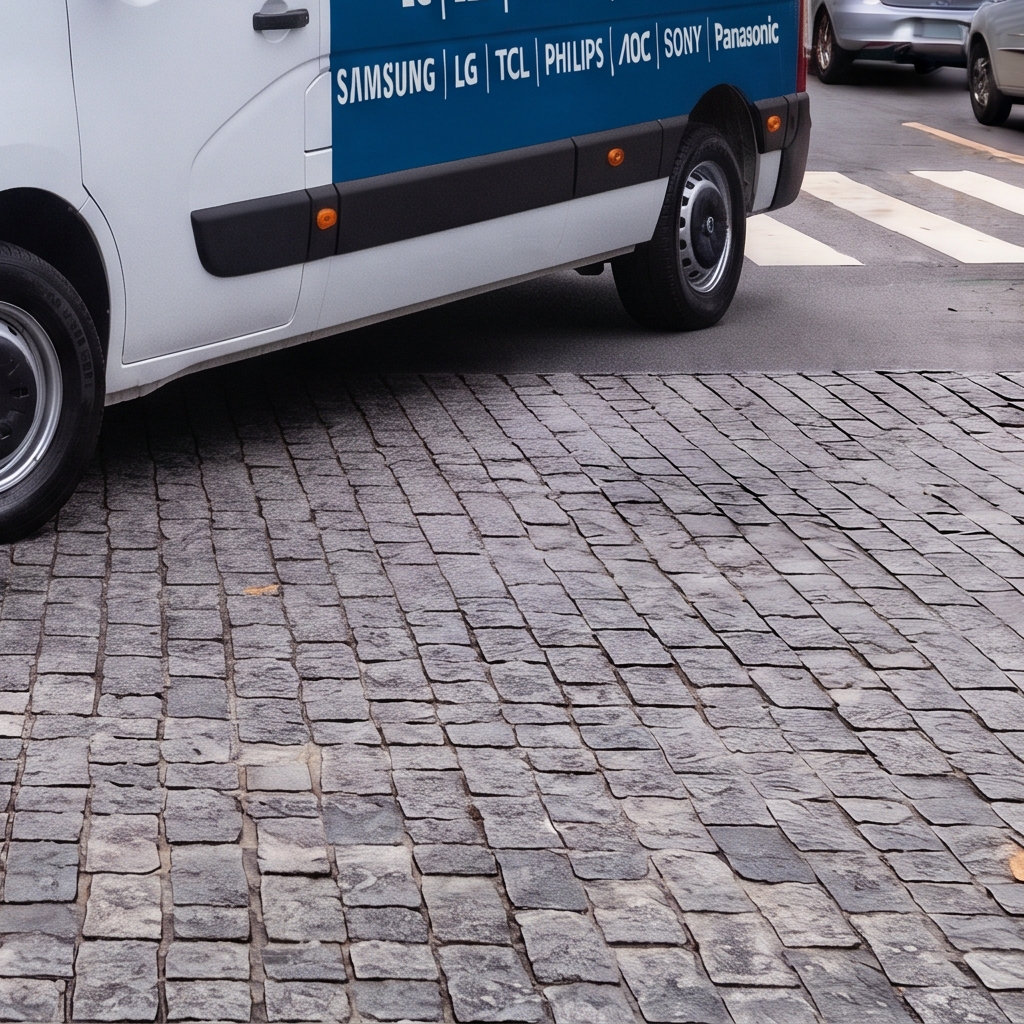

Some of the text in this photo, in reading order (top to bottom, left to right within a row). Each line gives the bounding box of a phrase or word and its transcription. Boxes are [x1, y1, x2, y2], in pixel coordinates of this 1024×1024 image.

[336, 15, 779, 105] SAMSUNG LG TCL PHILIPS AOC SONY Panasonic
